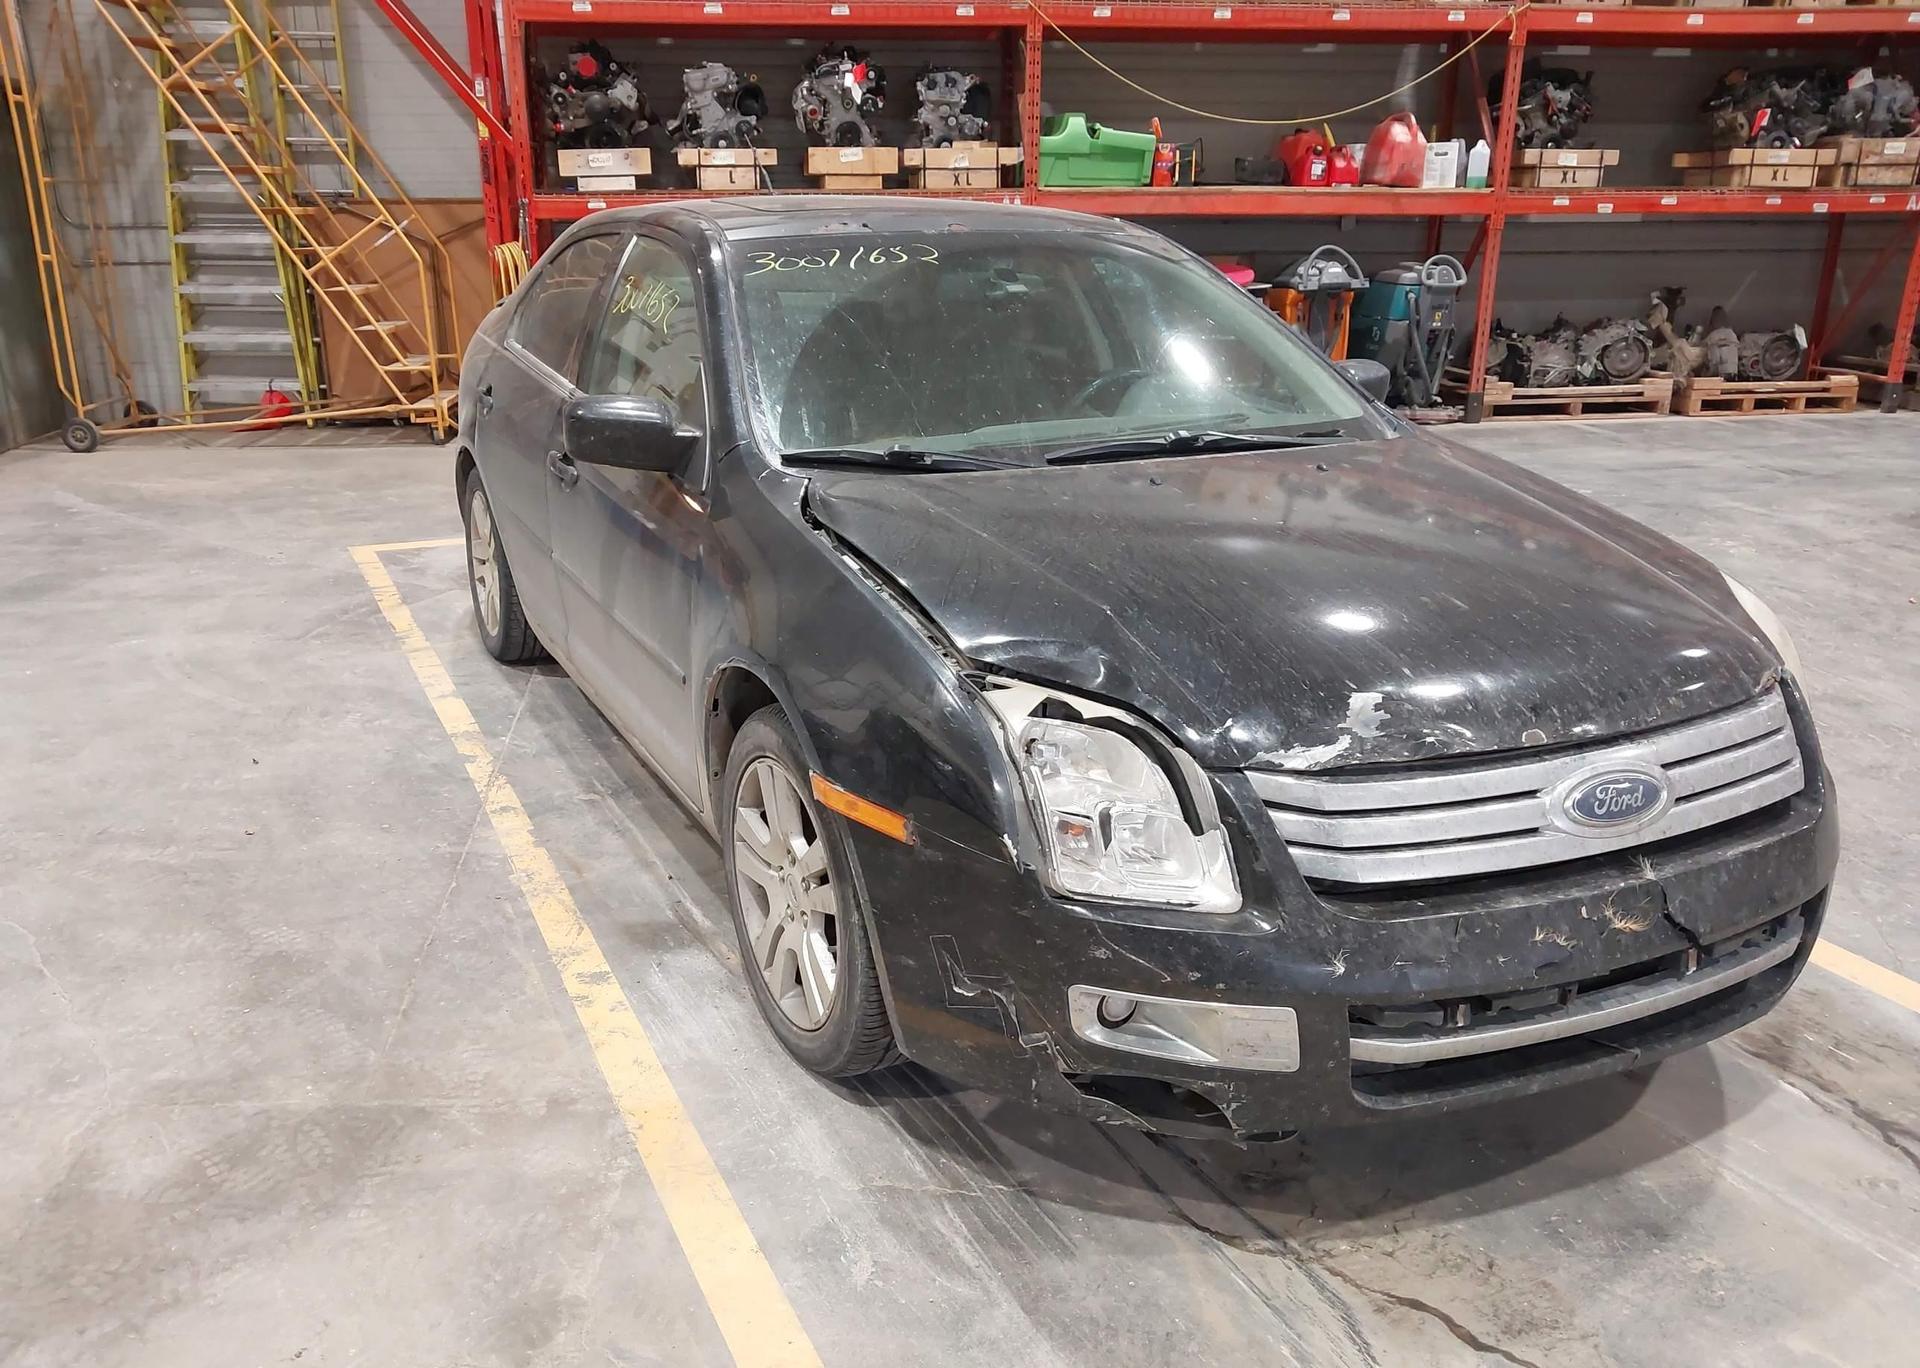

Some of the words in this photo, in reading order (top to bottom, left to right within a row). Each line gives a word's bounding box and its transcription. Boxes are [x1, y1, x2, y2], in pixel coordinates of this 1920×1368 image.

[953, 172, 972, 186] XL
[1561, 170, 1577, 184] XL
[1771, 168, 1789, 182] XL
[1594, 782, 1645, 815] Ford
